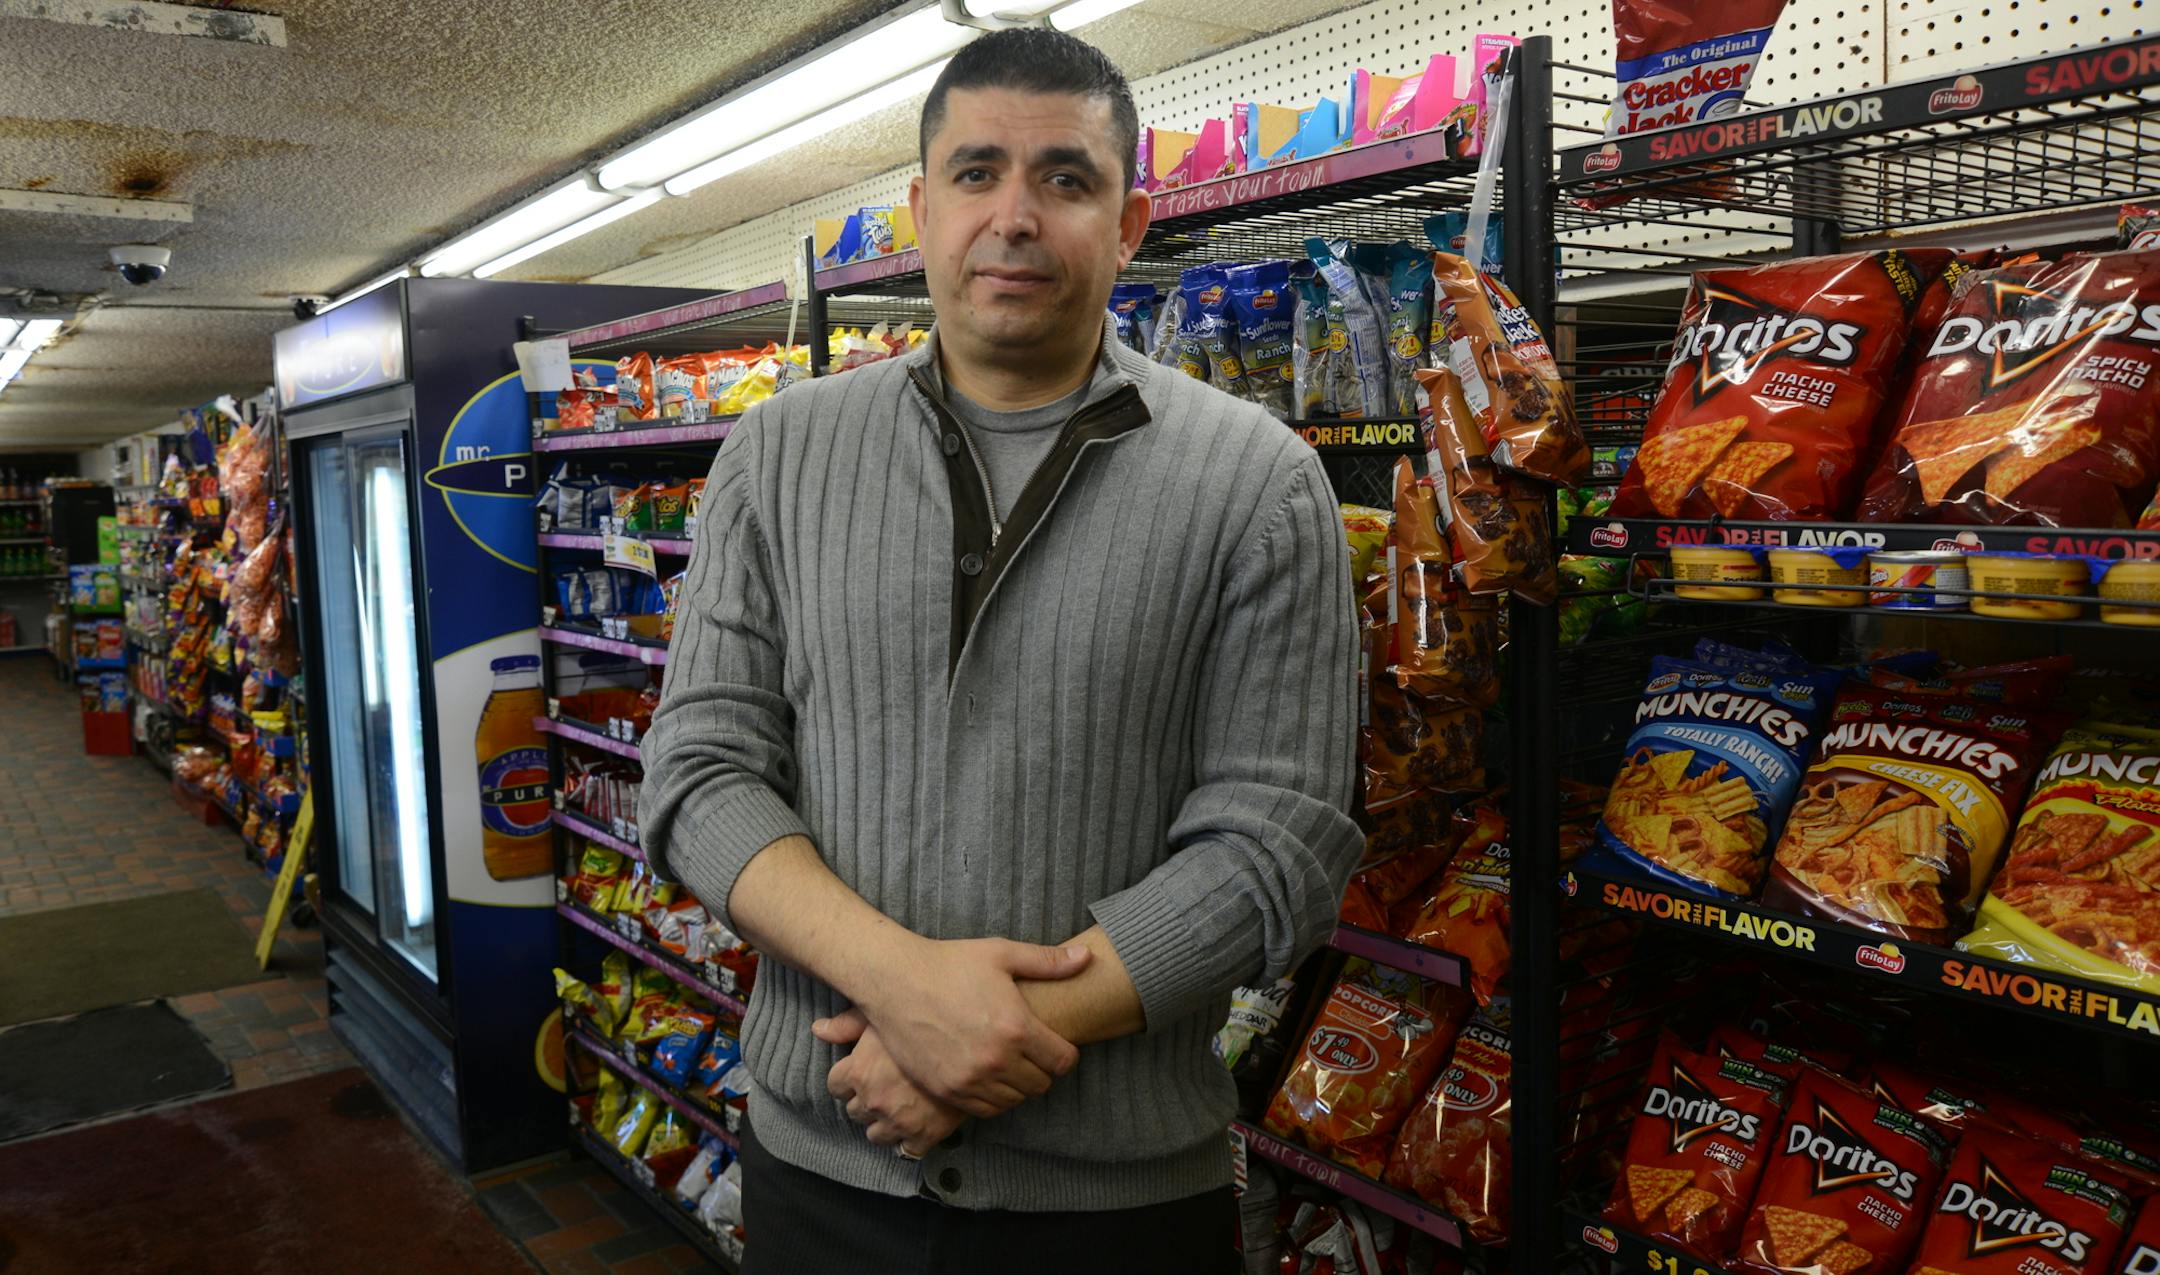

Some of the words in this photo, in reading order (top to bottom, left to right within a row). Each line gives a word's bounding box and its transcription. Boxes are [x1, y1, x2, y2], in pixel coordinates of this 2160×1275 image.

[1662, 56, 1688, 69] The
[1690, 36, 1757, 61] Original
[2024, 44, 2160, 96] SAVOR
[1622, 62, 1751, 111] Cracker
[1617, 102, 1694, 135] Jack
[1649, 122, 1745, 161] SAVOR
[1746, 119, 1758, 144] THE
[1759, 96, 1884, 142] FLAVOR
[1166, 187, 1220, 216] taste.
[1222, 174, 1274, 206] your
[1276, 164, 1326, 193] town.
[872, 260, 899, 280] your
[1245, 317, 1291, 341] Sunflower
[1927, 302, 2160, 358] Doritos
[1256, 342, 1292, 361] Ranch
[1667, 314, 1862, 374] Doritos
[2066, 366, 2146, 390] NACHO
[2085, 355, 2152, 376] SPICY
[1760, 383, 1833, 407] CHEESE
[1771, 371, 1837, 394] NACHO
[1341, 422, 1415, 446] FLAVOR
[1779, 681, 1815, 695] Sun
[1633, 690, 1810, 747] MUNCHIES
[1985, 714, 2027, 730] Sun
[1663, 725, 1728, 749] TOTALLY
[1723, 736, 1785, 785] RANCH!
[1820, 721, 2019, 780] MUNCHIES
[1867, 761, 1943, 789] CHEESE
[1937, 777, 1983, 818] FIX
[1602, 883, 1692, 924] SAVOR
[1692, 903, 1702, 925] THE
[1703, 905, 1816, 952] FLAVOR
[1860, 950, 1901, 970] FritoLay
[1940, 959, 2068, 1012] SAVOR
[2069, 988, 2083, 1015] THE
[2085, 992, 2160, 1036] FLA
[1331, 1049, 1360, 1067] ONLY
[1724, 1060, 1754, 1075] WIN
[1444, 1082, 1479, 1104] ONLY
[1643, 1087, 1761, 1141] Doritos
[1878, 1107, 1914, 1126] WIN
[1248, 1132, 1291, 1161] your
[1708, 1141, 1747, 1162] NACHO
[1703, 1149, 1744, 1171] CHEESE
[1786, 1124, 1919, 1199] Doritos
[2050, 1169, 2087, 1187] WIN
[2064, 1184, 2077, 1195] 2
[1857, 1201, 1901, 1230] CHEESE
[1864, 1195, 1904, 1220] NACHO
[1939, 1182, 2094, 1263] Doritos
